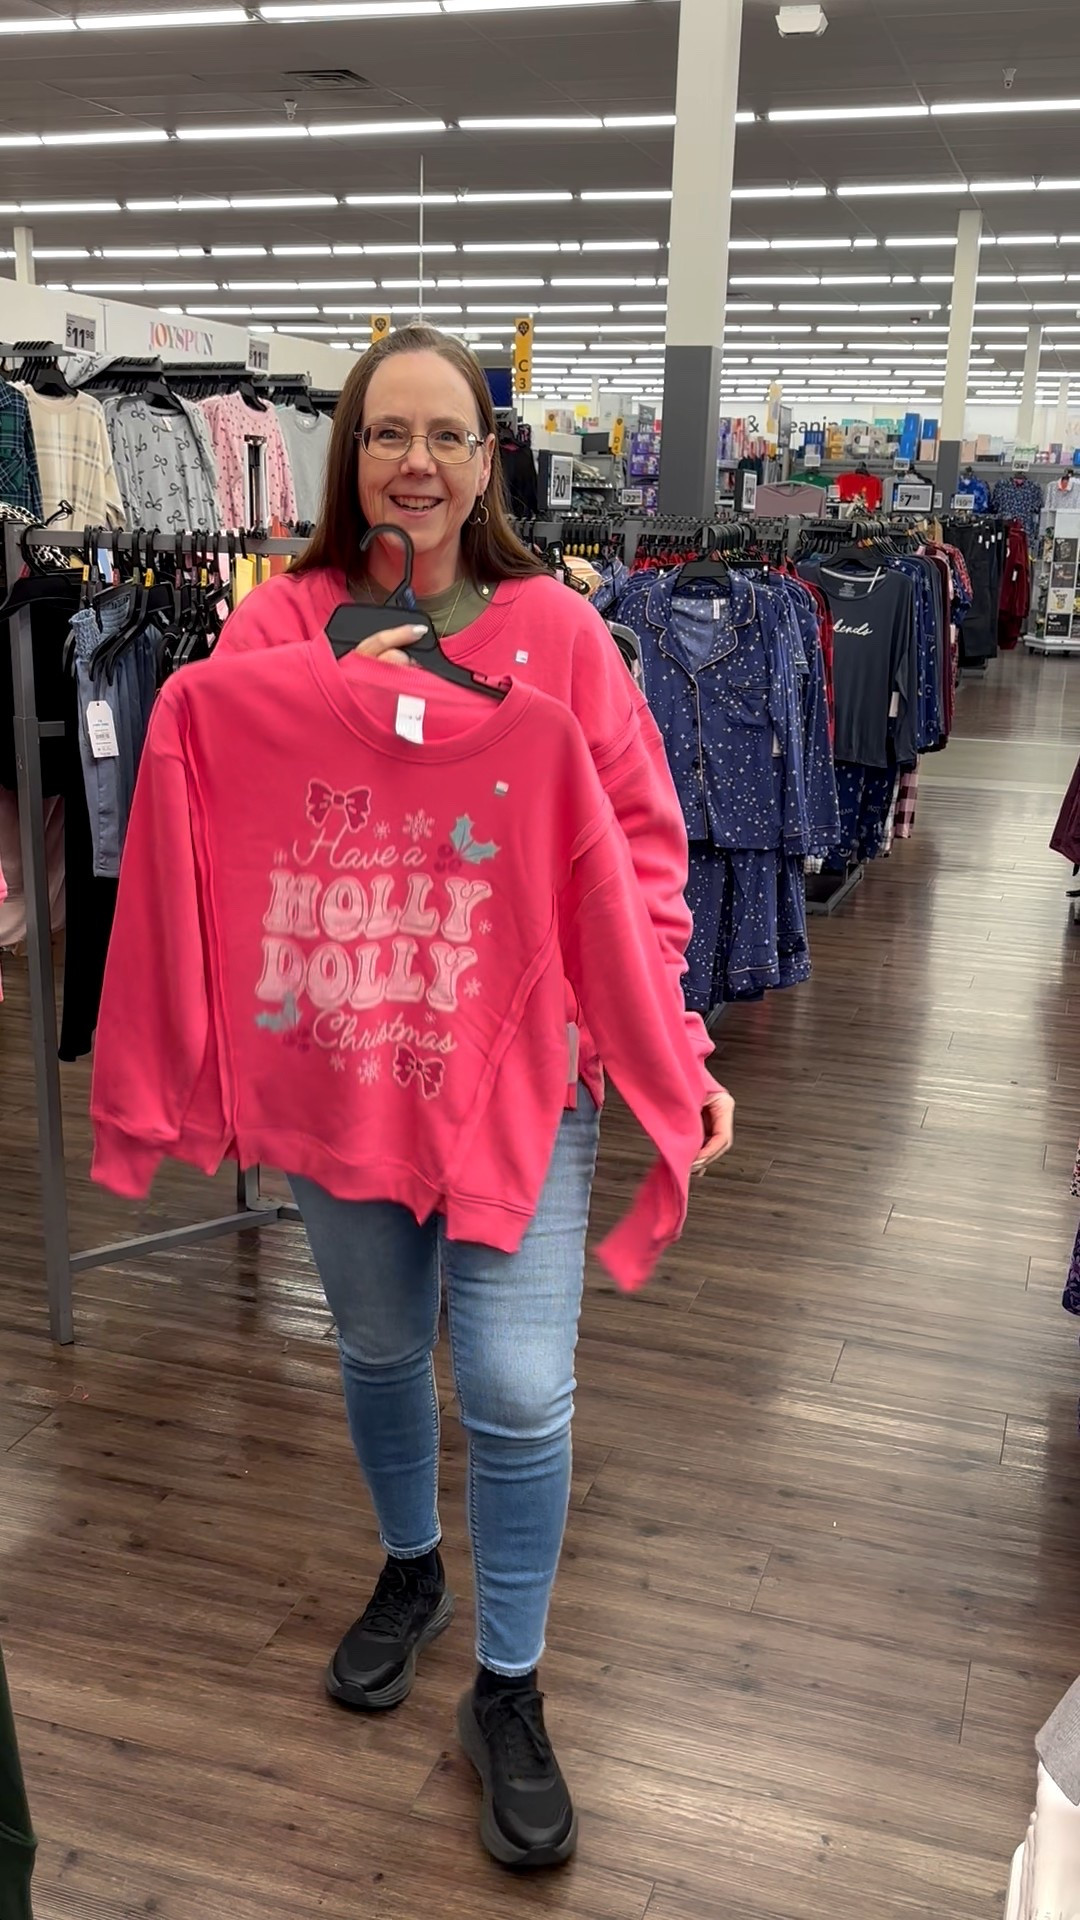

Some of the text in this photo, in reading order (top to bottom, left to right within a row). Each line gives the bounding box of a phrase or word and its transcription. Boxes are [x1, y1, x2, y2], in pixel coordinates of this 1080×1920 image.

[149, 321, 214, 356] JOYSPUN
[518, 359, 529, 372] C
[519, 377, 527, 390] 3
[748, 415, 760, 433] &
[292, 822, 427, 870] Have a
[262, 868, 493, 944] HOLLY
[254, 935, 479, 1013] DOLLY
[312, 1008, 457, 1054] Christmas
